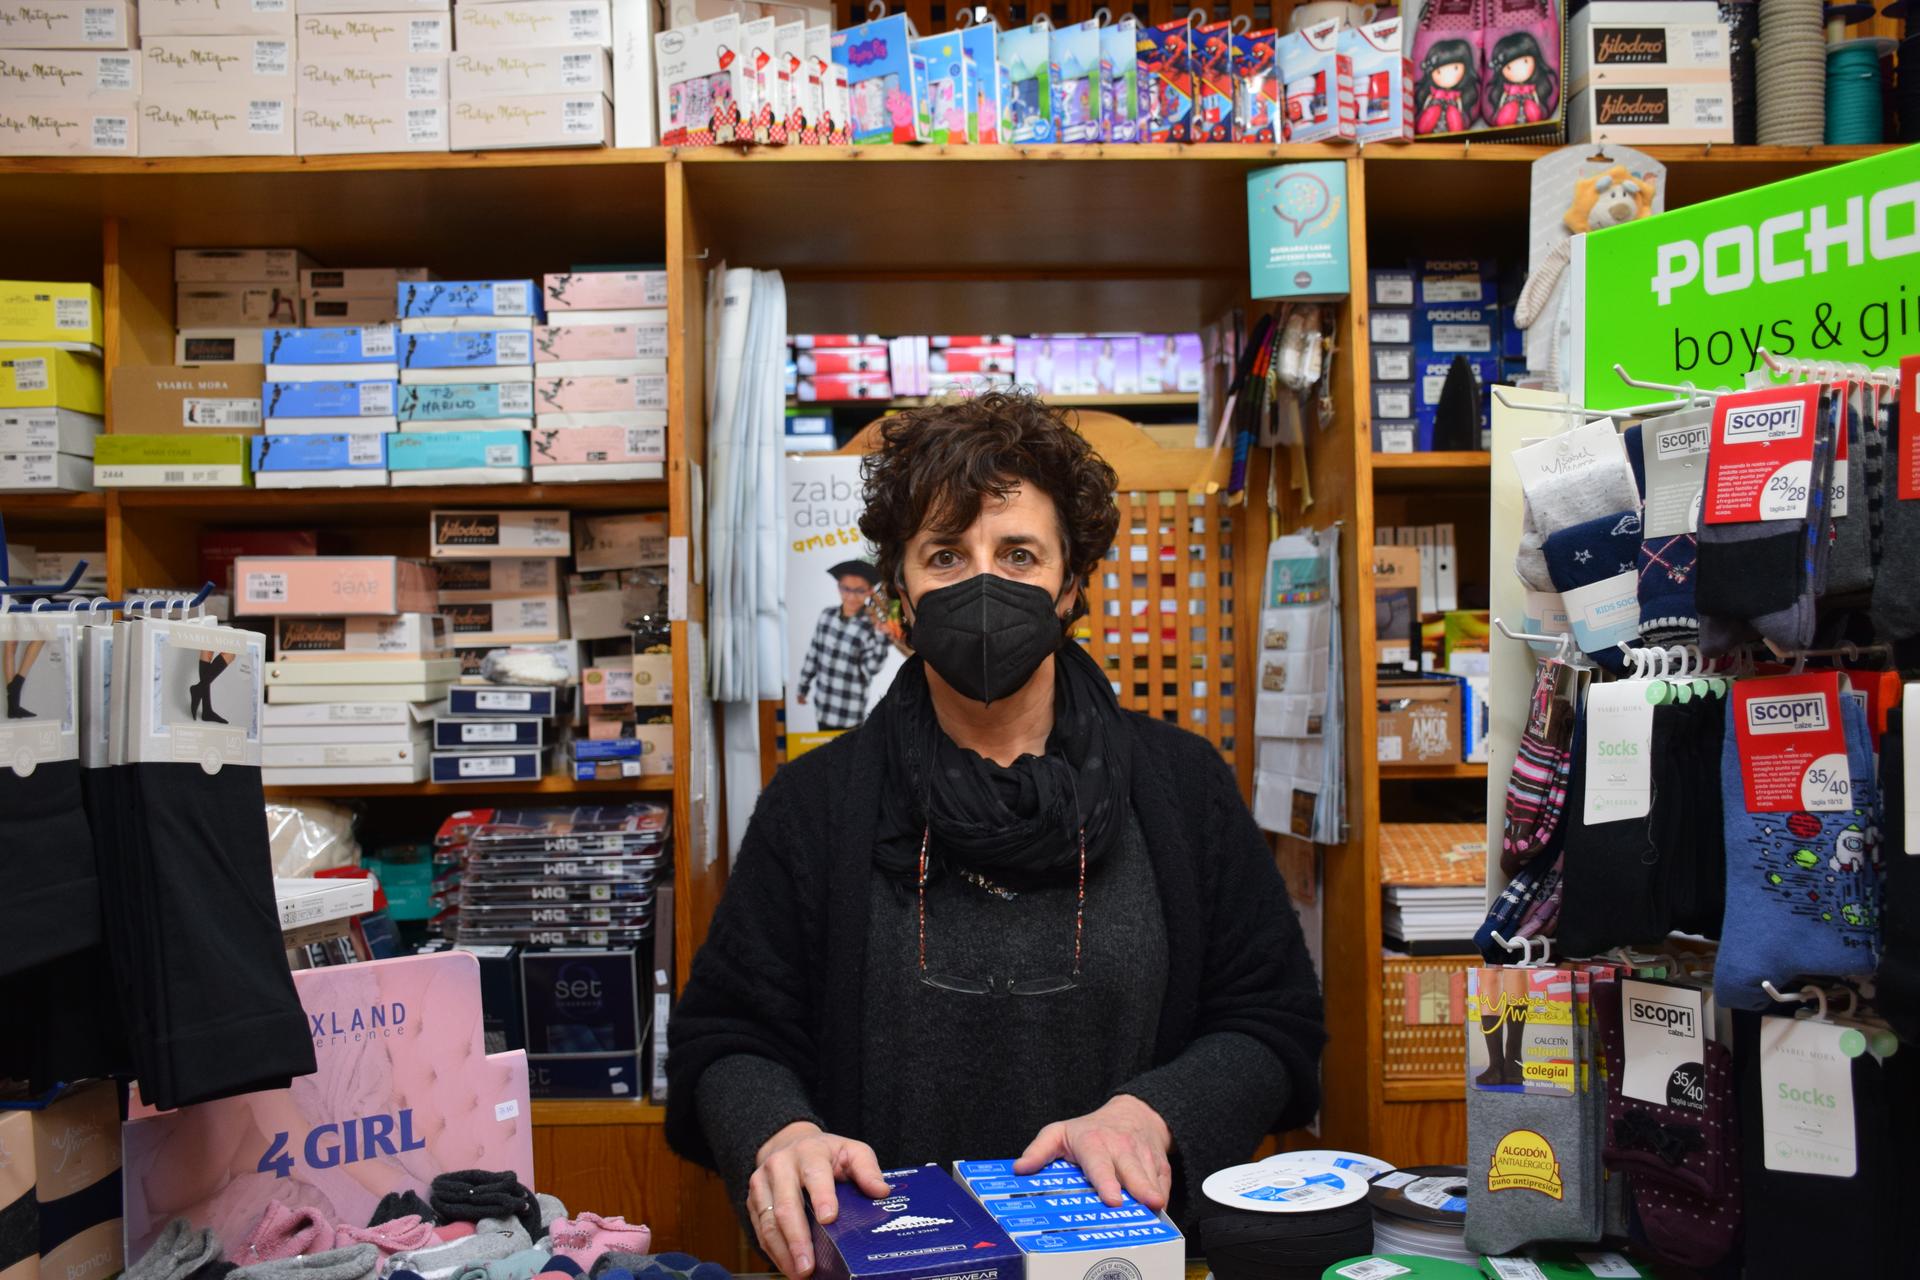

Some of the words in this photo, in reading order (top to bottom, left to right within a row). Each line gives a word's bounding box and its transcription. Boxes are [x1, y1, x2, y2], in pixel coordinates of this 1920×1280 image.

[1600, 32, 1664, 61] filodoro
[1601, 94, 1665, 123] filodoro
[1427, 310, 1481, 321] POCHOLO
[1674, 319, 1795, 377] boys
[1811, 302, 1842, 350] &
[156, 381, 193, 391] YSABEL
[198, 381, 229, 391] MORA
[438, 519, 497, 543] filodoro
[792, 527, 860, 553] amets
[1412, 718, 1448, 744] AMOR
[1597, 739, 1638, 757] Socks
[555, 979, 602, 998] set
[1526, 1065, 1568, 1079] colegial
[1673, 1070, 1703, 1101] 35/40
[1778, 1082, 1836, 1109] Socks
[257, 1131, 294, 1179] 4
[303, 1108, 426, 1170] GIRL
[1502, 1146, 1547, 1159] ALGODÓN
[1060, 1208, 1146, 1223] PRIVATA
[1077, 1227, 1166, 1242] PRIVATA
